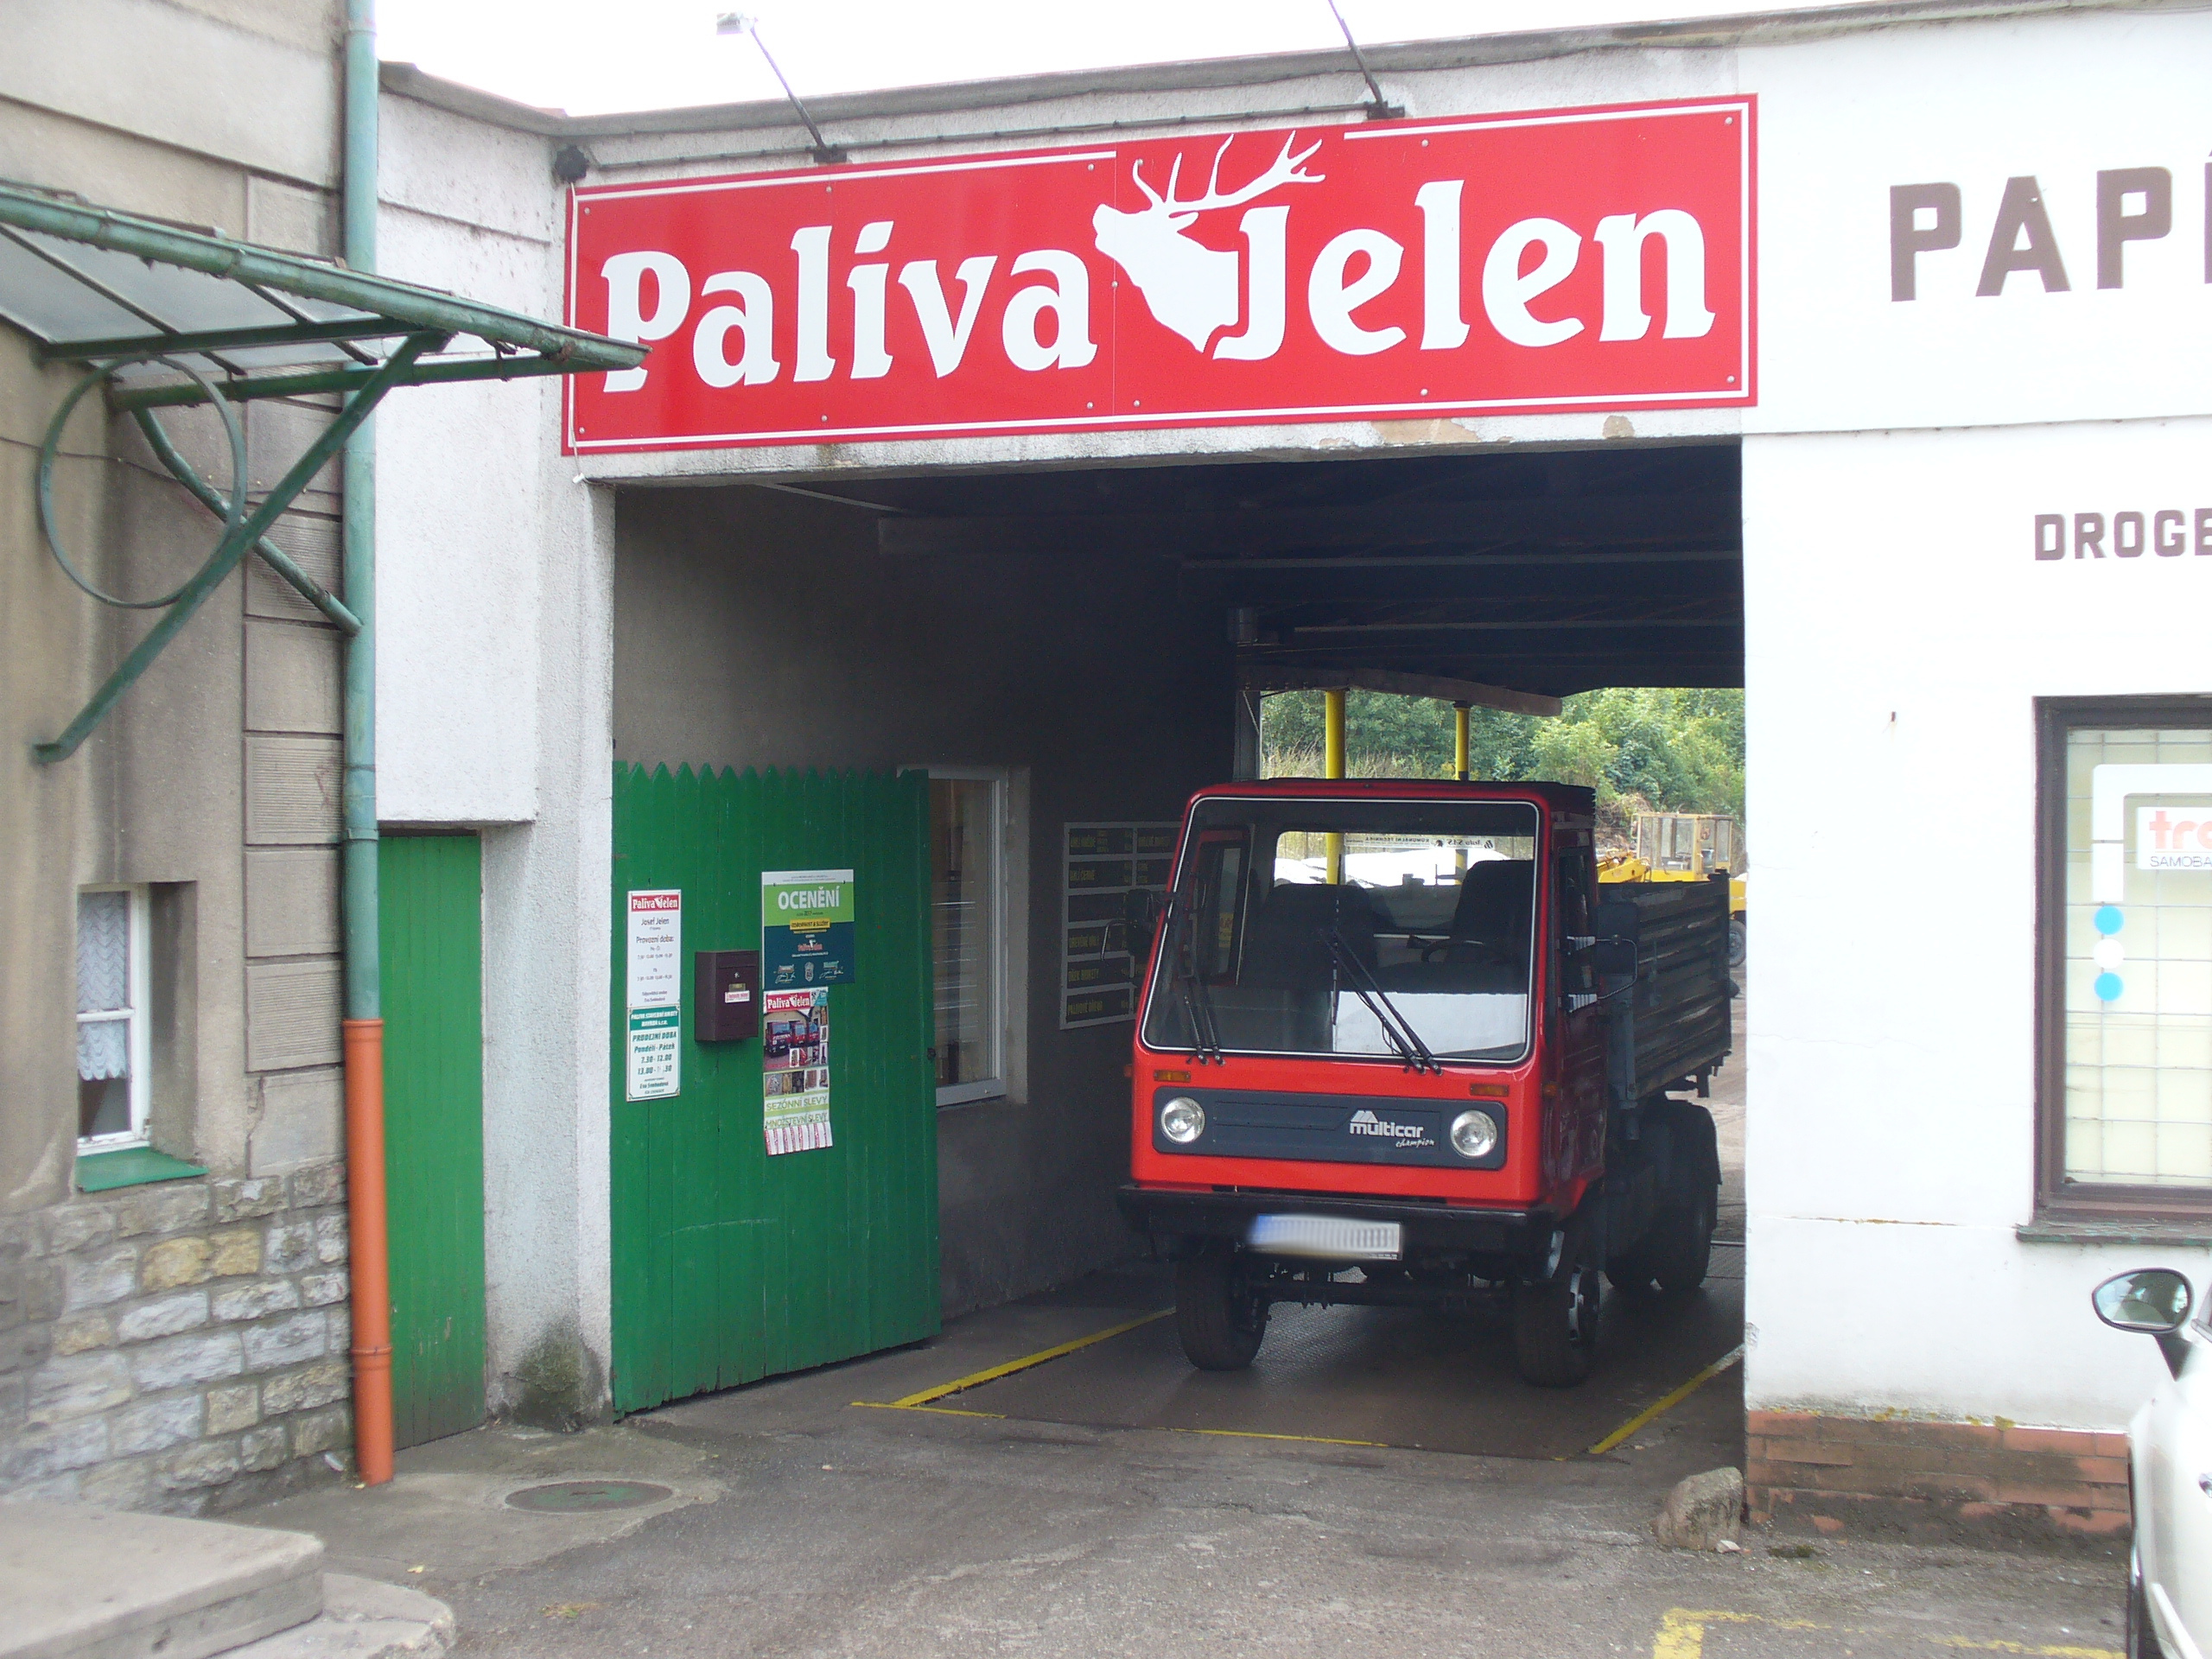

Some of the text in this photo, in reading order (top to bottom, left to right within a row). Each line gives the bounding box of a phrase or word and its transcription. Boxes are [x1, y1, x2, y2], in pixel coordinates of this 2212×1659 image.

[600, 179, 1716, 394] Paliva Jelen
[632, 898, 655, 909] Paliva
[778, 885, 841, 911] OCENĚNÍ
[766, 997, 790, 1010] Paliva
[632, 1031, 677, 1042] PRODEJNÍ DOBA
[766, 1095, 827, 1111] SEZÓNNÍ SLEVY
[808, 1112, 828, 1122] SLEVY
[1349, 1121, 1424, 1139] multicar
[1395, 1136, 1435, 1149] champion
